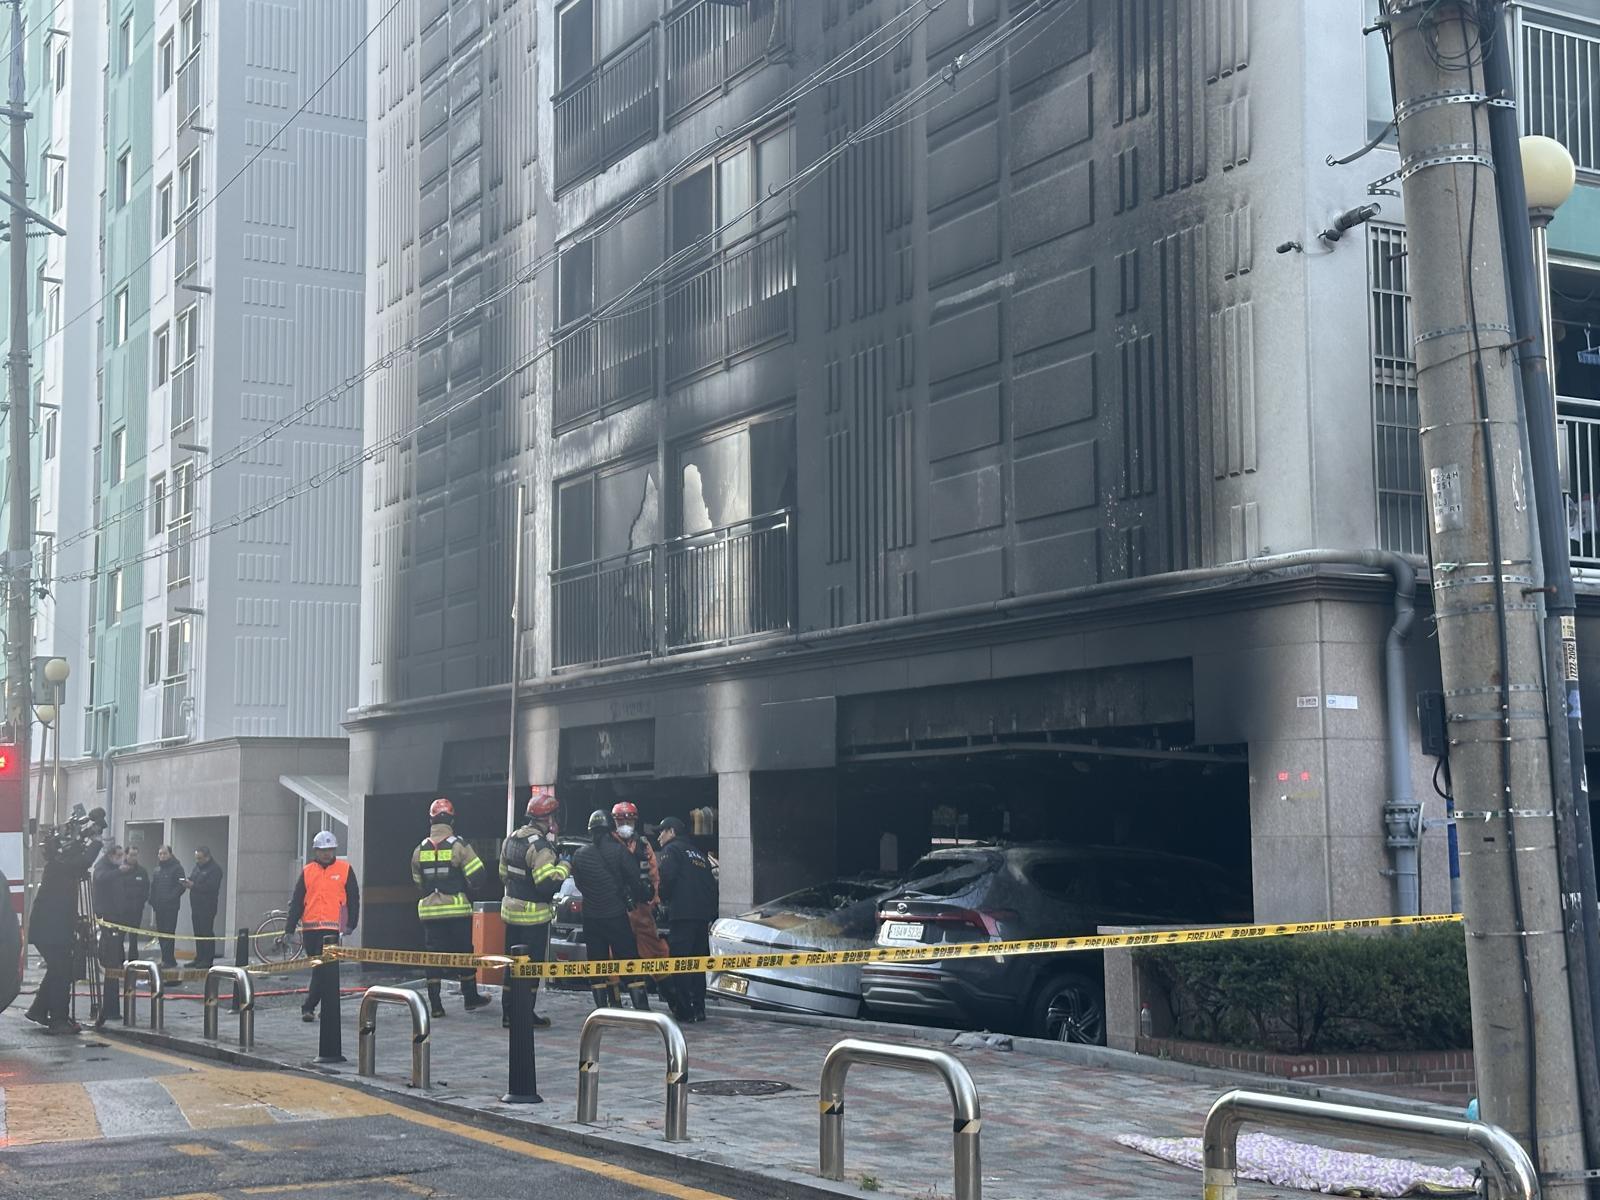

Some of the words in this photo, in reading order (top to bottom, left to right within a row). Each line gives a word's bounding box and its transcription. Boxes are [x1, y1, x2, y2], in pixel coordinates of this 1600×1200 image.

[520, 964, 543, 976] 출입통제
[563, 963, 576, 975] FIRE
[577, 963, 591, 975] LINE
[595, 961, 620, 974] 출입통제
[641, 961, 655, 973] FIRE
[655, 960, 670, 972] LINE
[674, 959, 700, 971] 출입통제
[721, 957, 736, 969] FIRE
[736, 956, 752, 968] LINE
[756, 954, 784, 967] 출입통제
[806, 953, 821, 965] FIRE
[821, 952, 838, 964] LINE
[841, 950, 871, 962] 출입통제
[894, 949, 910, 960] FIRE
[910, 948, 928, 959] LINE
[931, 946, 962, 957] 출입통제
[986, 944, 1003, 954] FIRE
[1003, 943, 1021, 953] LINE
[1084, 938, 1101, 948] FIRE
[1101, 937, 1121, 947] LINE
[1186, 932, 1205, 941] FIRE
[1205, 930, 1225, 940] LINE
[1230, 927, 1266, 938] 출입통제
